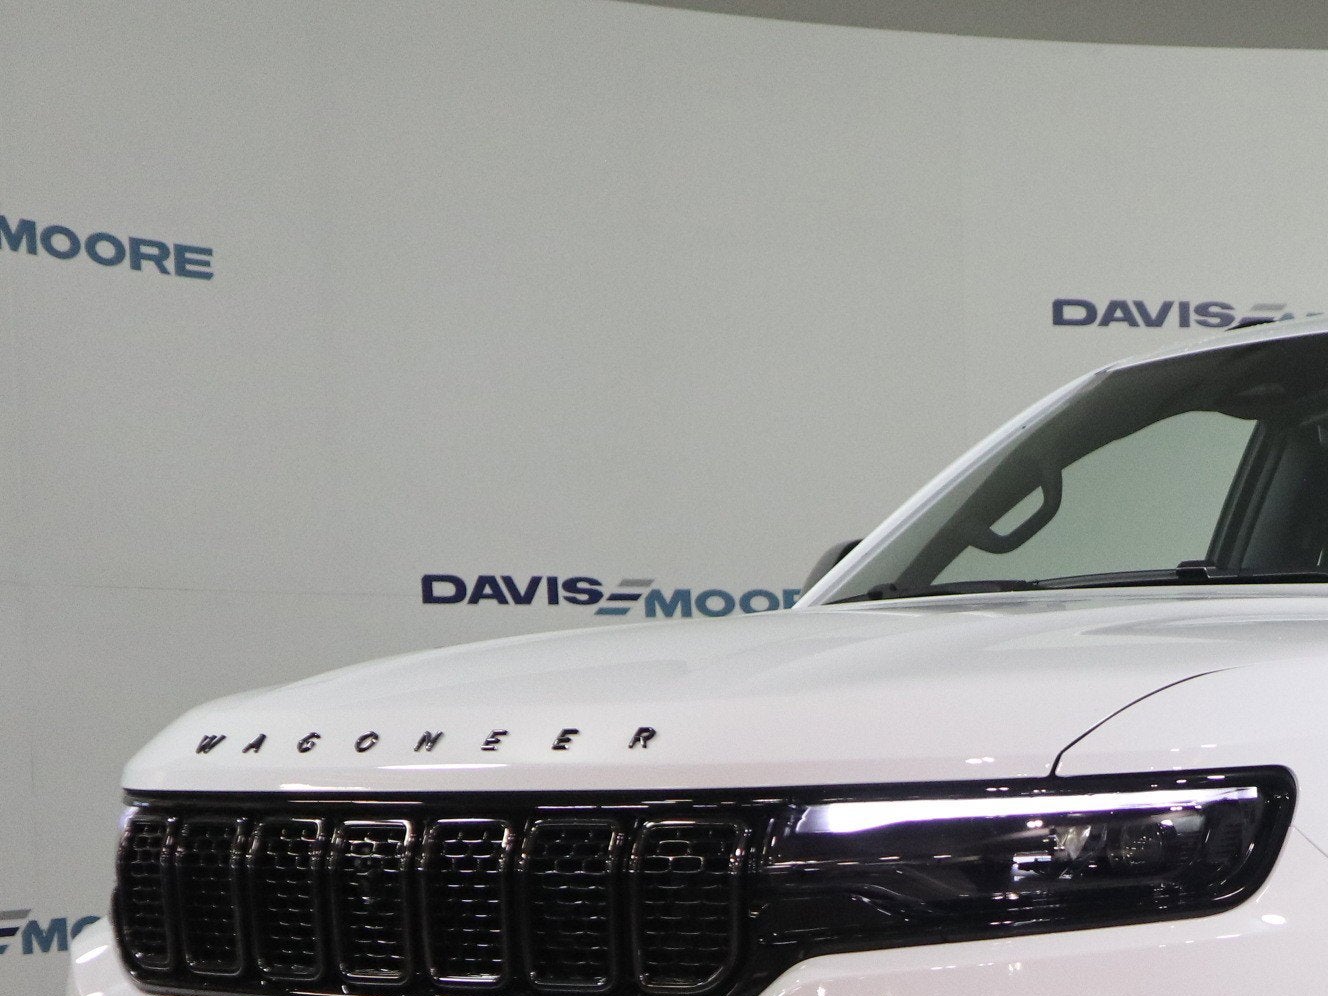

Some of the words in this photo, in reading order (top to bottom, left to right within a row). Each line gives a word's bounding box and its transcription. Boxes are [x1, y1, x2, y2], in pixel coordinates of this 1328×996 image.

[0, 215, 214, 281] MOORE
[1052, 298, 1236, 328] DAVIS
[421, 574, 605, 605] DAVIS
[196, 726, 658, 754] WAGONEER
